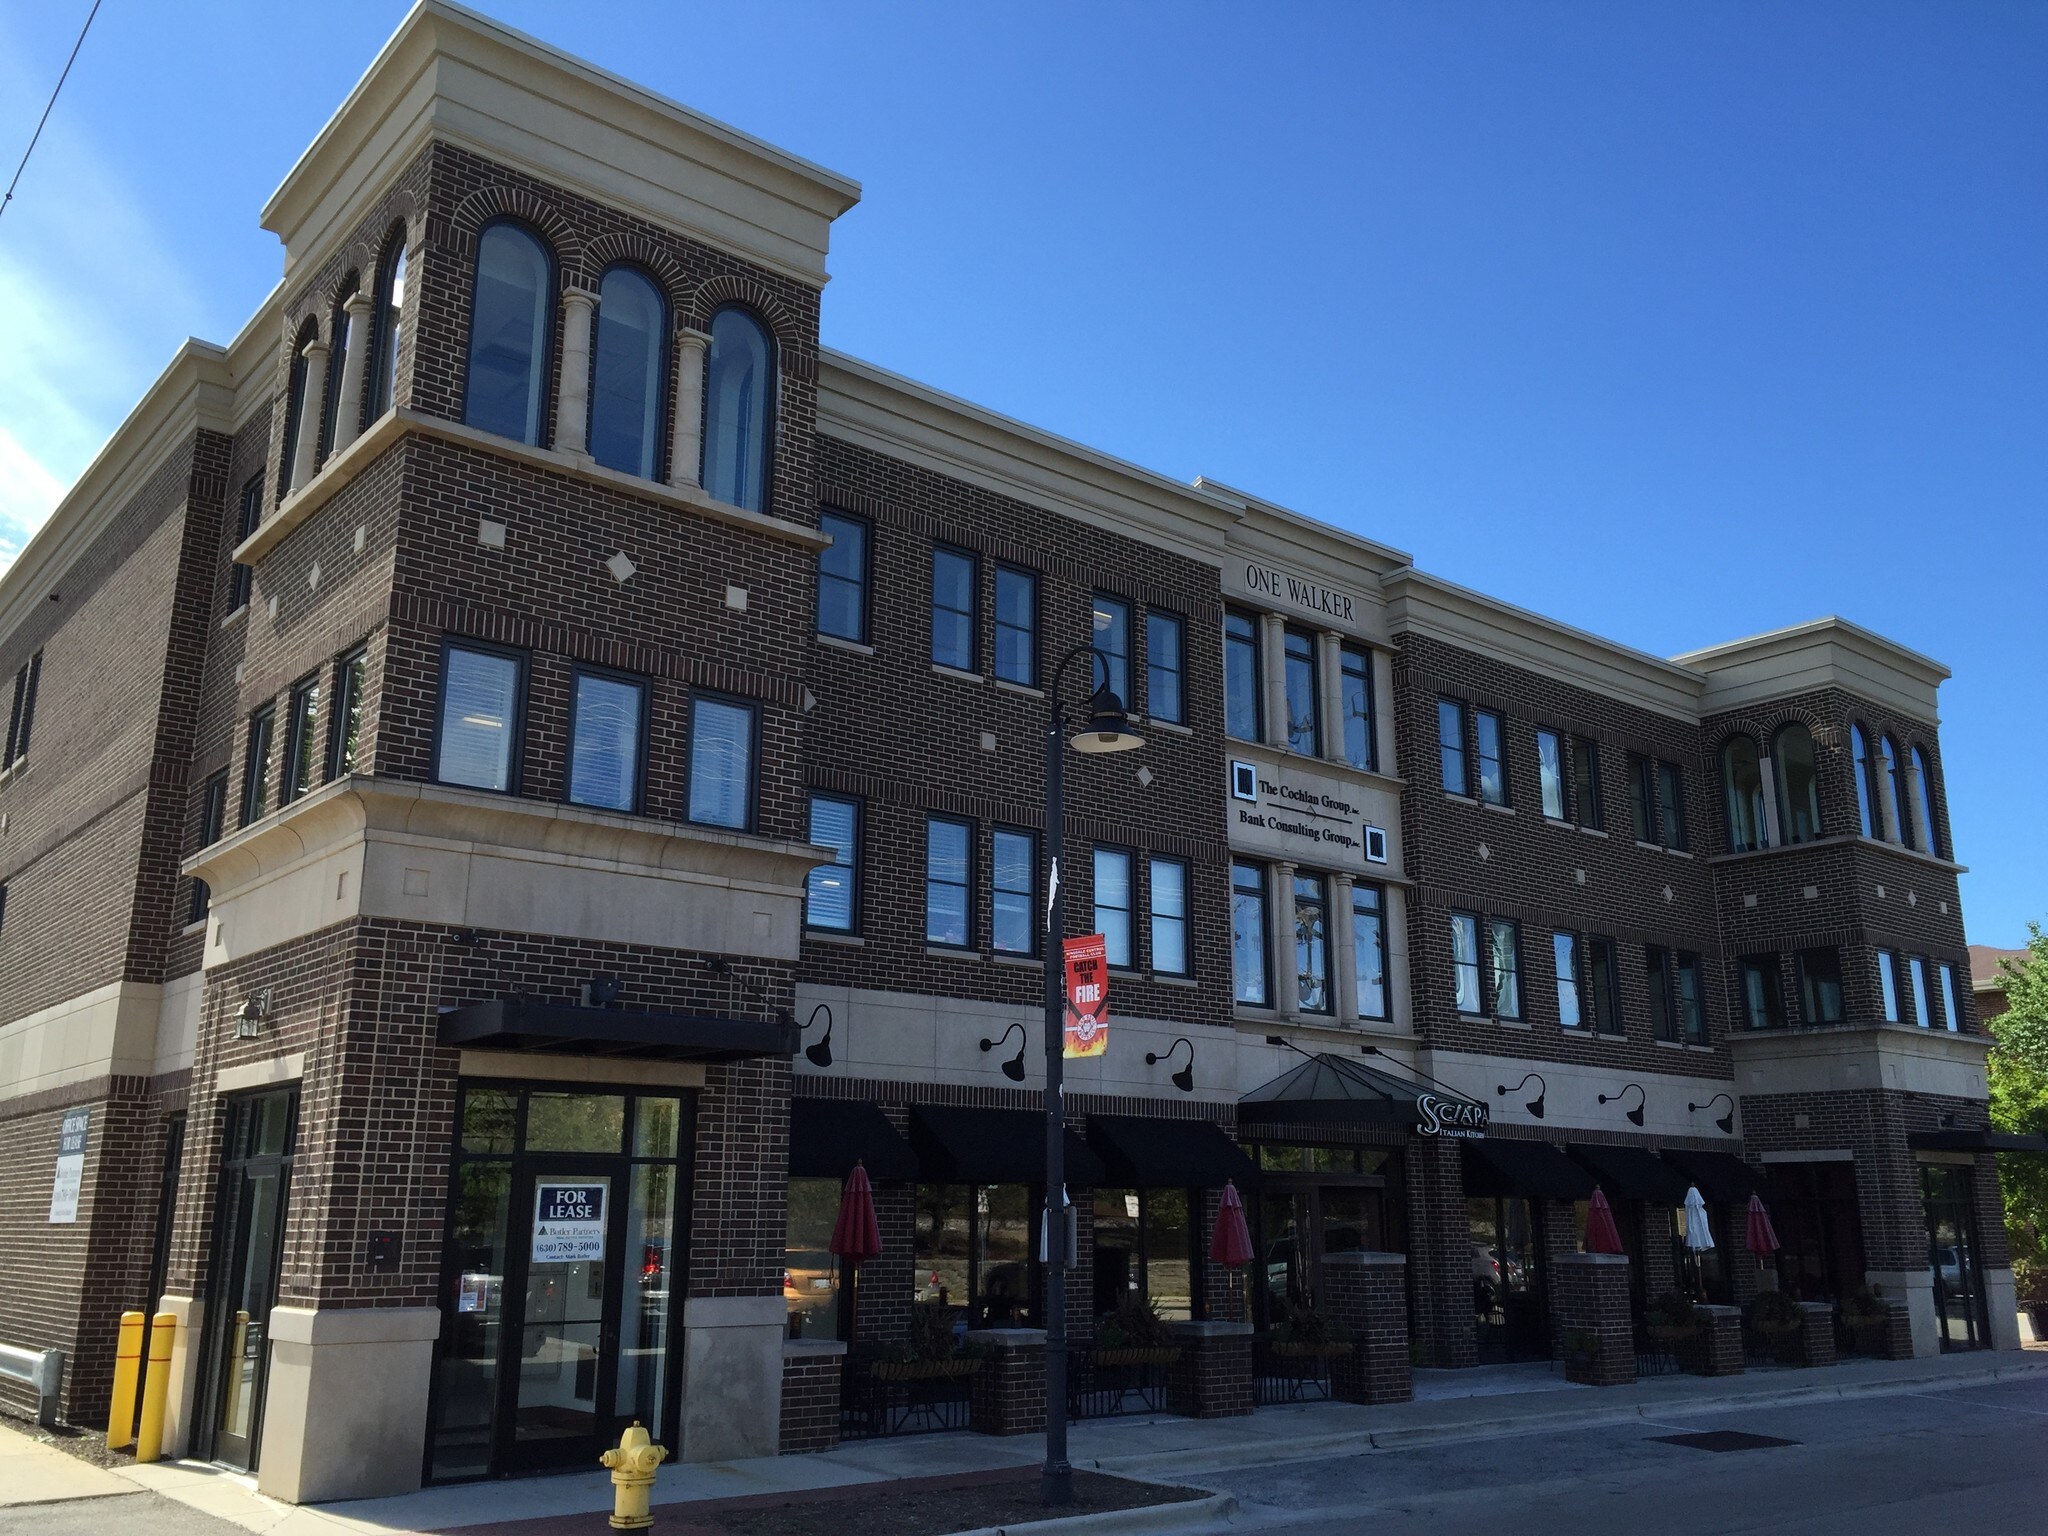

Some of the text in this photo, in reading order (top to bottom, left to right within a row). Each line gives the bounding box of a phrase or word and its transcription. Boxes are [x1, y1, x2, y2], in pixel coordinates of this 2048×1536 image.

[1246, 564, 1354, 621] ONE WALKER
[1258, 779, 1278, 796] The
[1280, 785, 1320, 806] Cochlan
[1239, 810, 1266, 828] Bank
[1267, 816, 1320, 842] Consulting
[1073, 959, 1098, 973] CATCH
[1080, 972, 1093, 984] THE
[1075, 984, 1100, 1004] FIRE
[556, 1190, 587, 1204] FOR
[549, 1205, 593, 1218] LEASE
[549, 1227, 600, 1236] Butler Partners
[536, 1241, 600, 1253] (630) 789-5000
